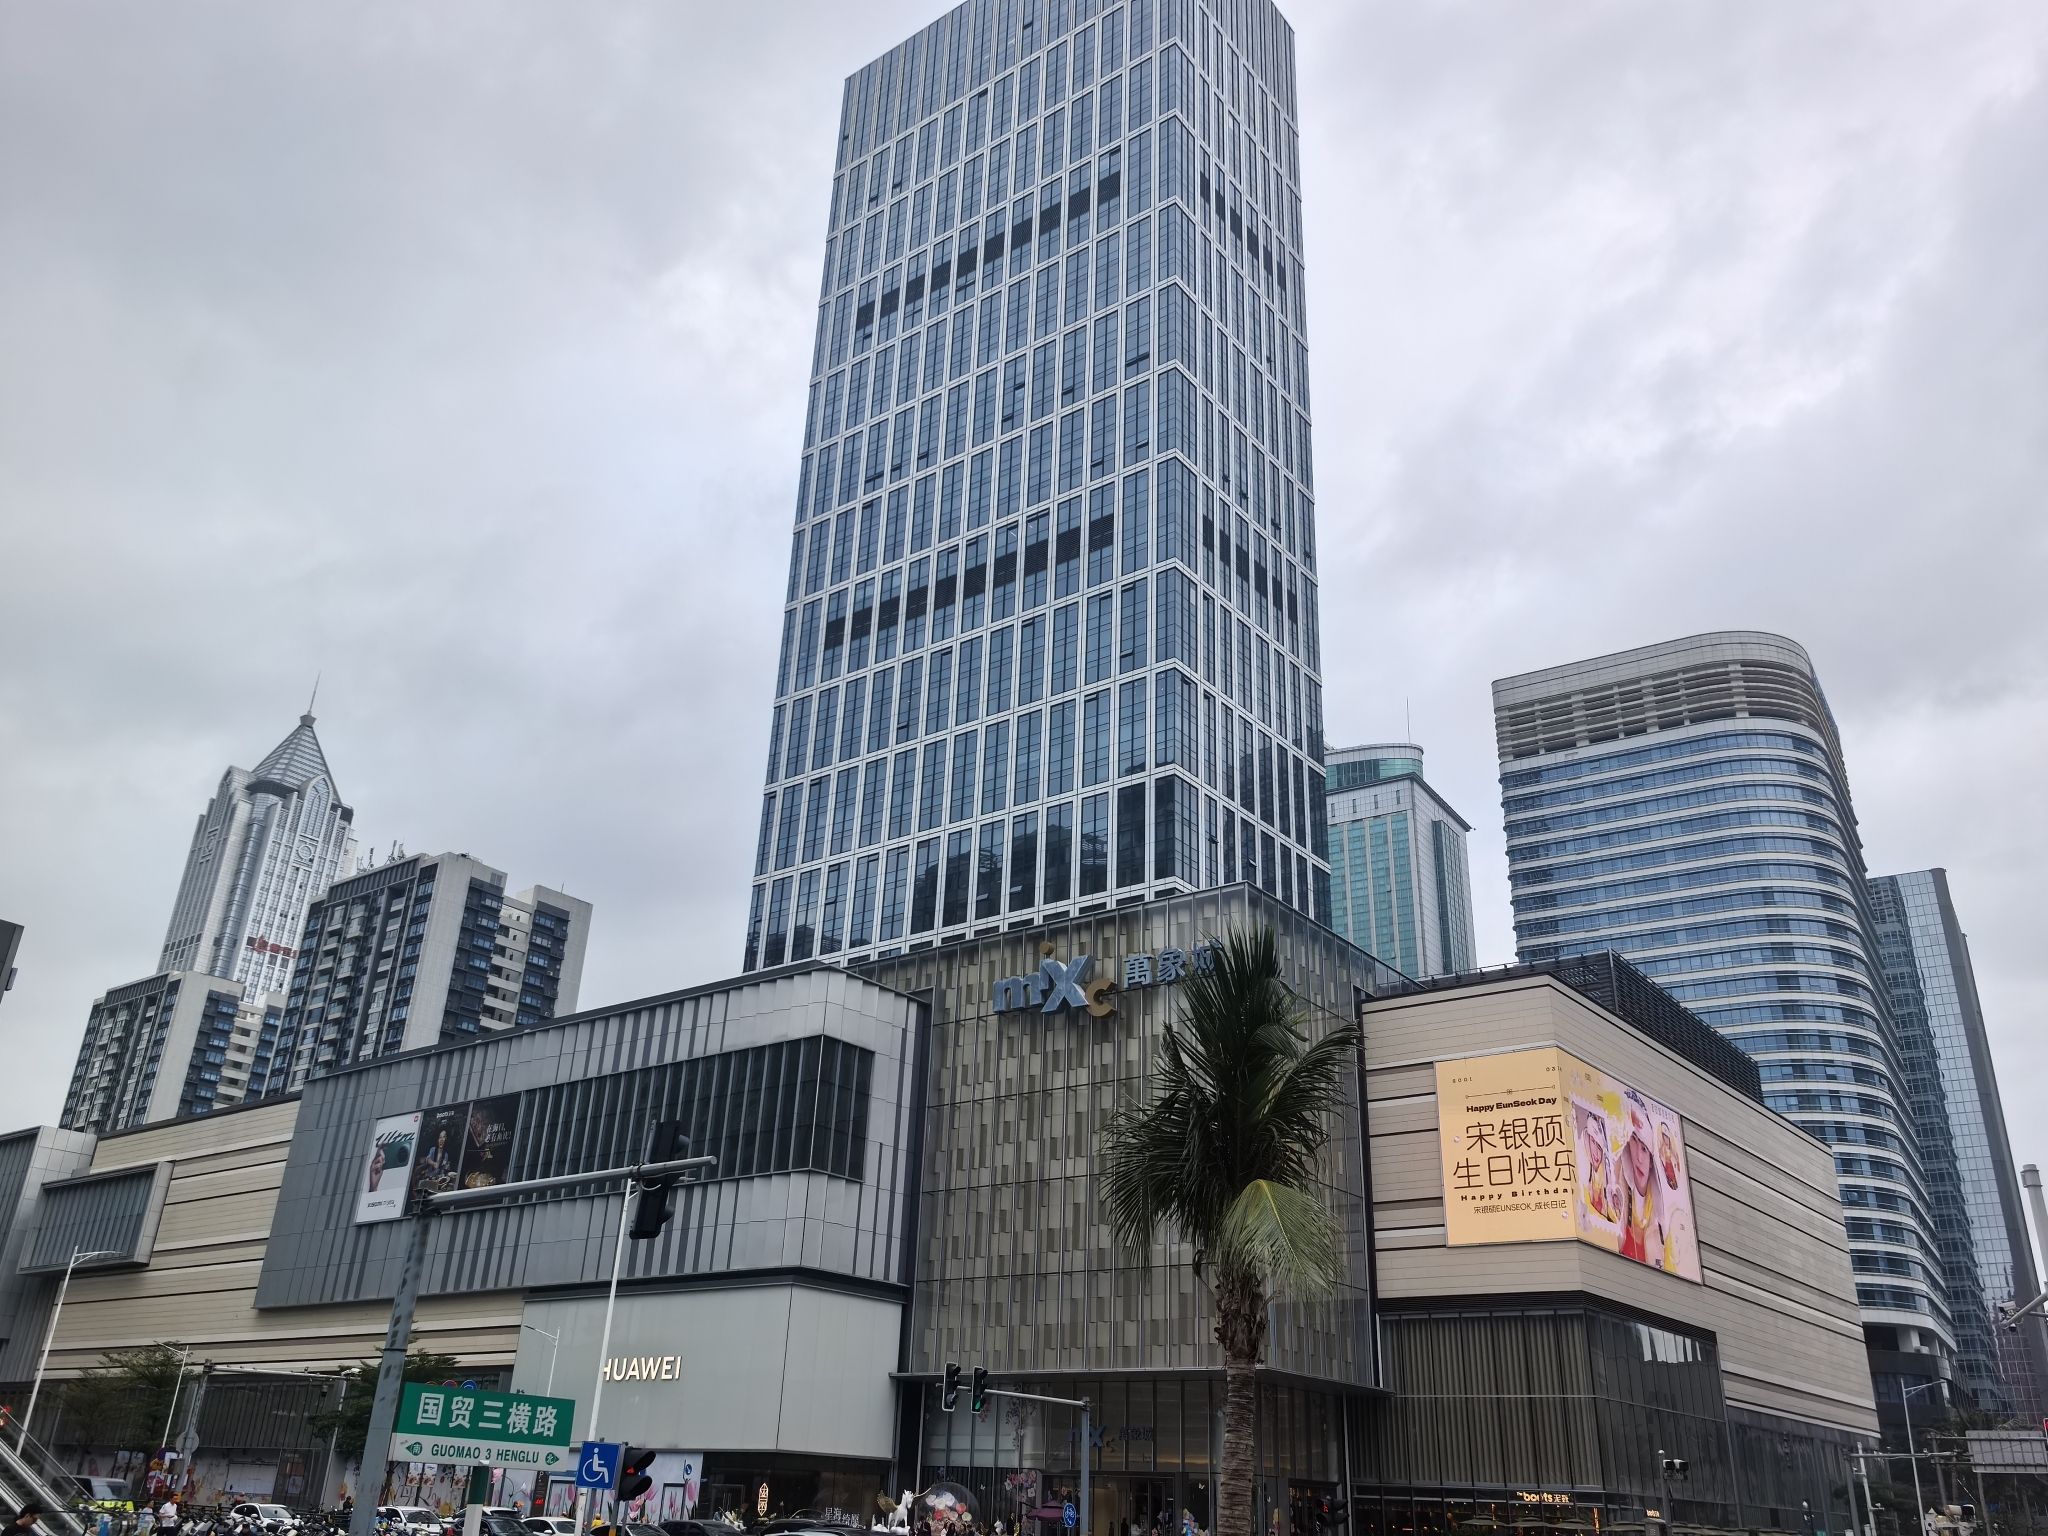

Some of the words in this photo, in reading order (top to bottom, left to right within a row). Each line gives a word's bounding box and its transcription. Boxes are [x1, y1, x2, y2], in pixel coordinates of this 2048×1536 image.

[1466, 1104, 1494, 1113] Happy
[1496, 1098, 1537, 1110] EunSeok
[1538, 1096, 1557, 1105] Day
[1466, 1114, 1566, 1154] 宋银硕
[1453, 1149, 1577, 1190] 生日快乐
[1460, 1192, 1503, 1202] Happy
[603, 1355, 682, 1381] HUAWEI
[416, 1392, 558, 1438] 国贸三横路
[431, 1443, 481, 1459] GUOMAO
[485, 1447, 492, 1460] 3
[496, 1448, 540, 1464] HENGLU
